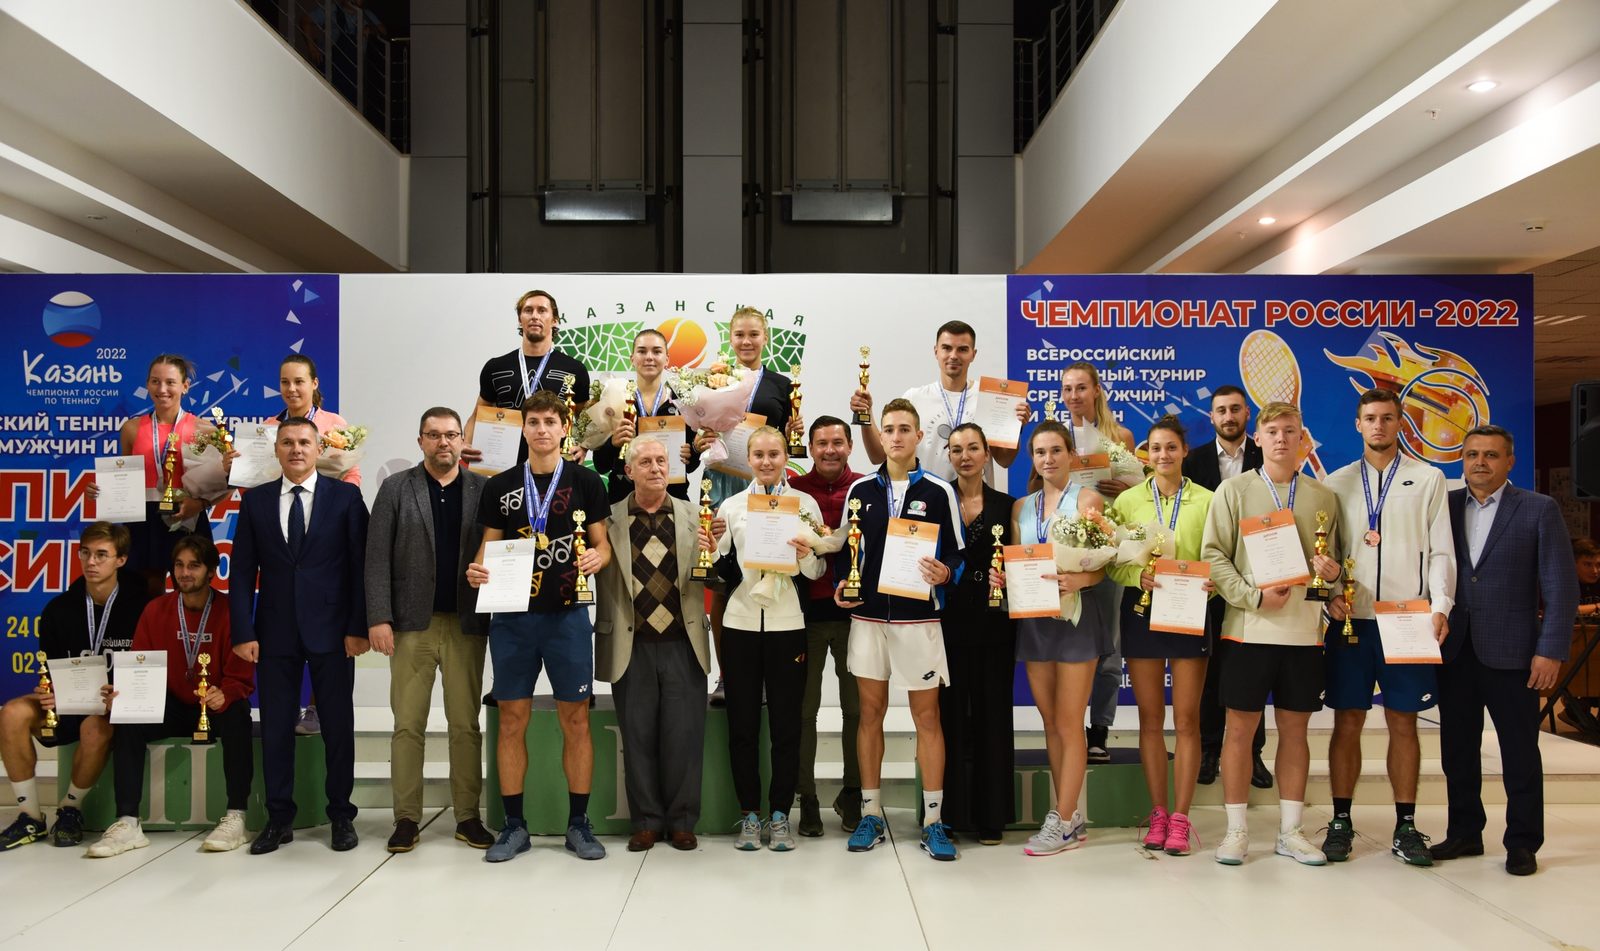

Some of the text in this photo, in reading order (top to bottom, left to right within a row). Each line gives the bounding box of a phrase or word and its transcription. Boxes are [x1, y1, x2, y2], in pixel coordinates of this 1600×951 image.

[1021, 300, 1256, 328] ЧЕМПИОНАТ
[96, 348, 126, 359] 2022
[1027, 346, 1175, 361] ВСЕРОССИЙСКИЙ
[23, 350, 122, 386] Казань
[1139, 369, 1206, 381] ТУРНИР
[62, 397, 101, 405] ТЕННИСУ
[1027, 390, 1165, 403] СРЕ УЖЧИН
[0, 412, 129, 431] КИЙ ТЕННИ
[103, 439, 117, 454] И
[6, 616, 29, 638] 24
[12, 652, 35, 673] 02
